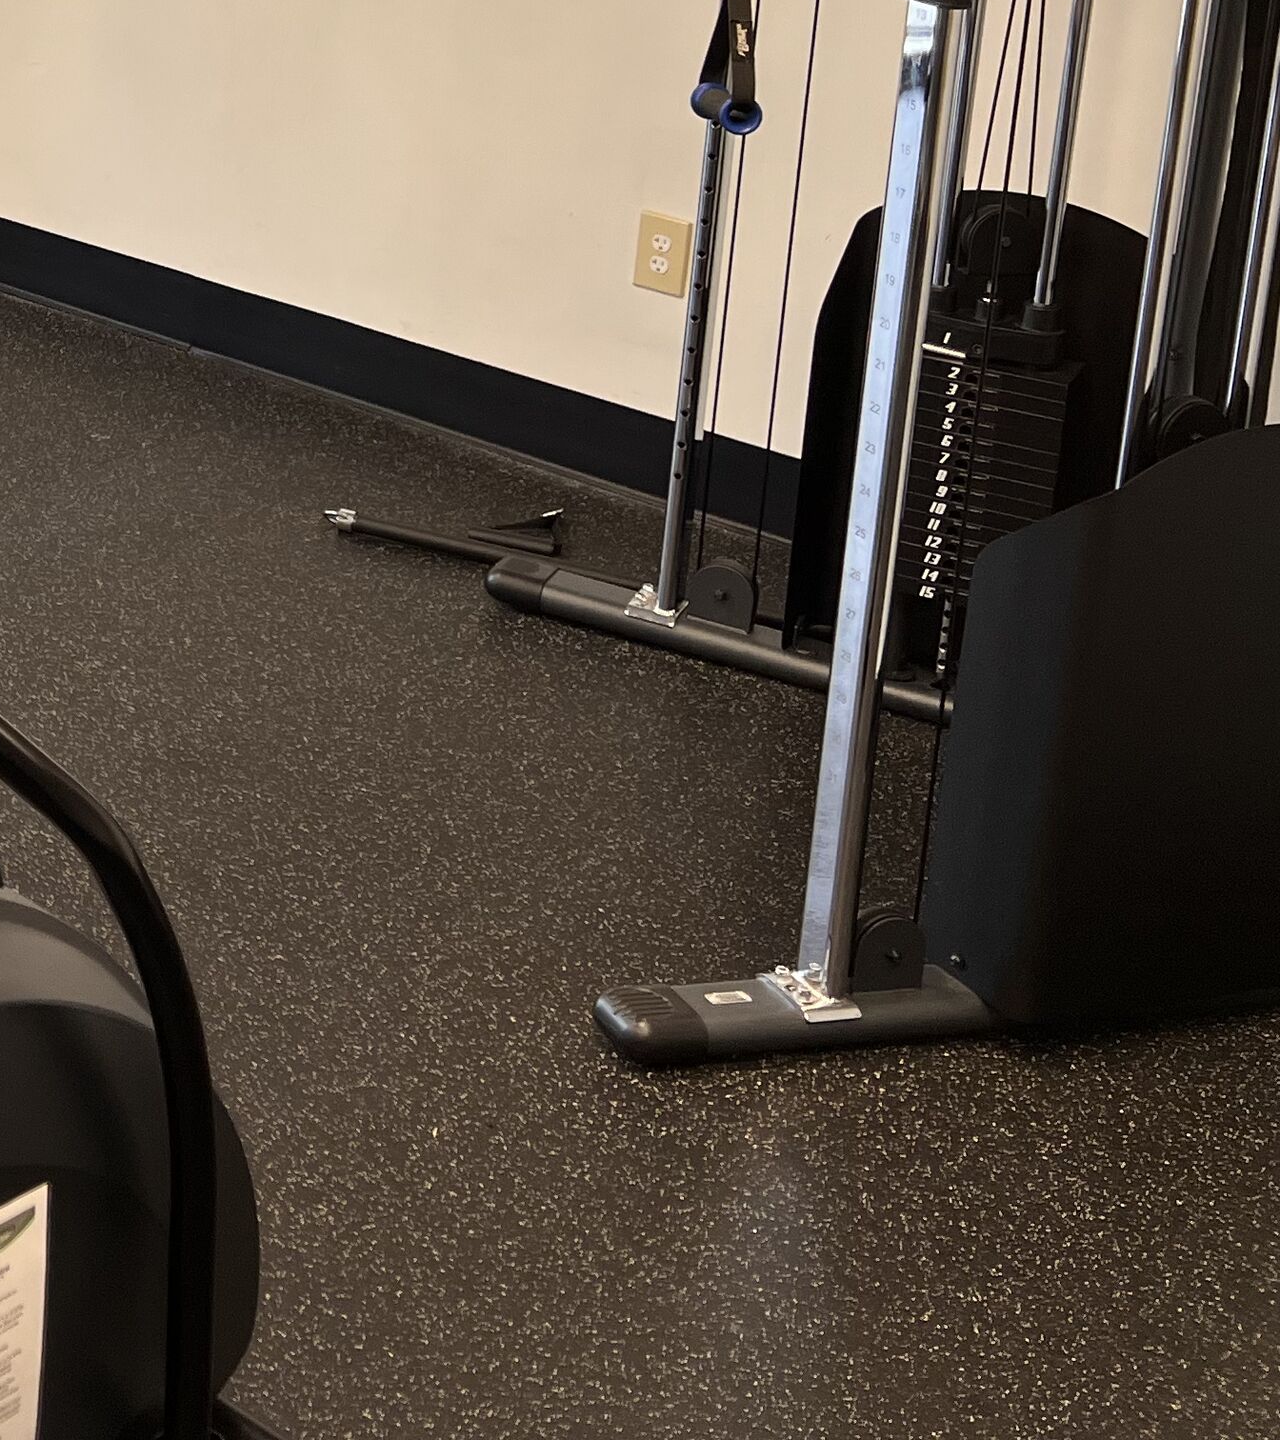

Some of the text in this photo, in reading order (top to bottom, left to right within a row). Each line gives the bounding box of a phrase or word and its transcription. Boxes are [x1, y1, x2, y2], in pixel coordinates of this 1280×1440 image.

[906, 97, 917, 111] 15
[900, 143, 911, 156] 16
[895, 186, 906, 199] 17
[885, 273, 895, 287] 19
[879, 316, 891, 330] 20
[942, 331, 952, 345] 1
[874, 358, 886, 371] 21
[947, 366, 961, 379] 2
[945, 382, 959, 396] 3
[869, 401, 881, 415] 22
[944, 401, 957, 414] 4
[941, 417, 955, 430] 5
[864, 440, 876, 455] 23
[940, 434, 954, 447] 6
[938, 451, 951, 464] 7
[935, 469, 948, 482] 8
[859, 483, 871, 498] 24
[935, 485, 948, 498] 9
[929, 501, 947, 515] 10
[926, 517, 941, 531] 11
[854, 525, 866, 540] 25
[924, 534, 942, 549] 12
[923, 551, 942, 566] 13
[921, 568, 939, 582] 14
[918, 585, 937, 599] 15
